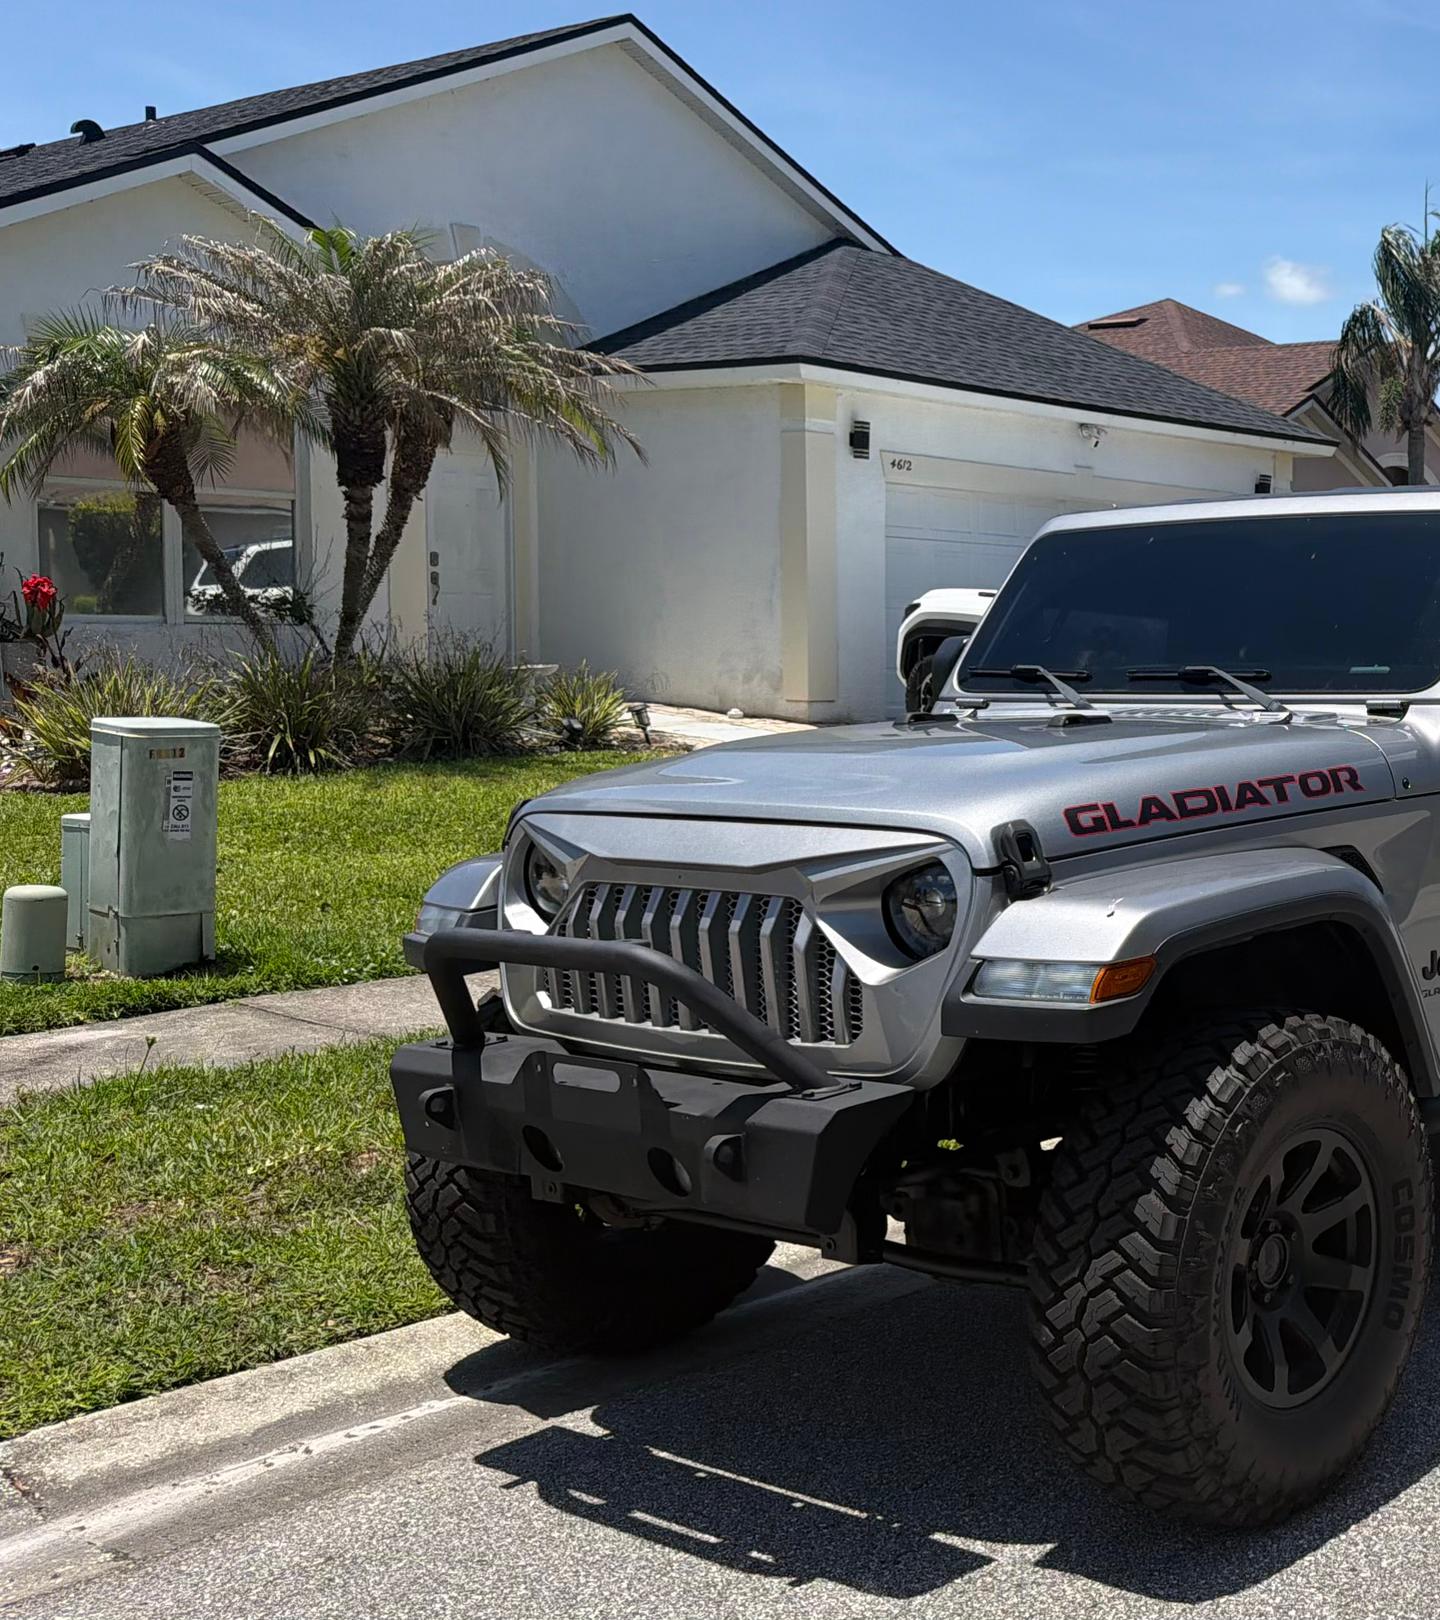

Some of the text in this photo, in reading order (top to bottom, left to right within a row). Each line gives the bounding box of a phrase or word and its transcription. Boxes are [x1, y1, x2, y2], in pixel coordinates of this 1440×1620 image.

[890, 459, 912, 471] 4612
[1062, 764, 1367, 838] GLADIATOR
[1384, 1177, 1416, 1331] COSMO
